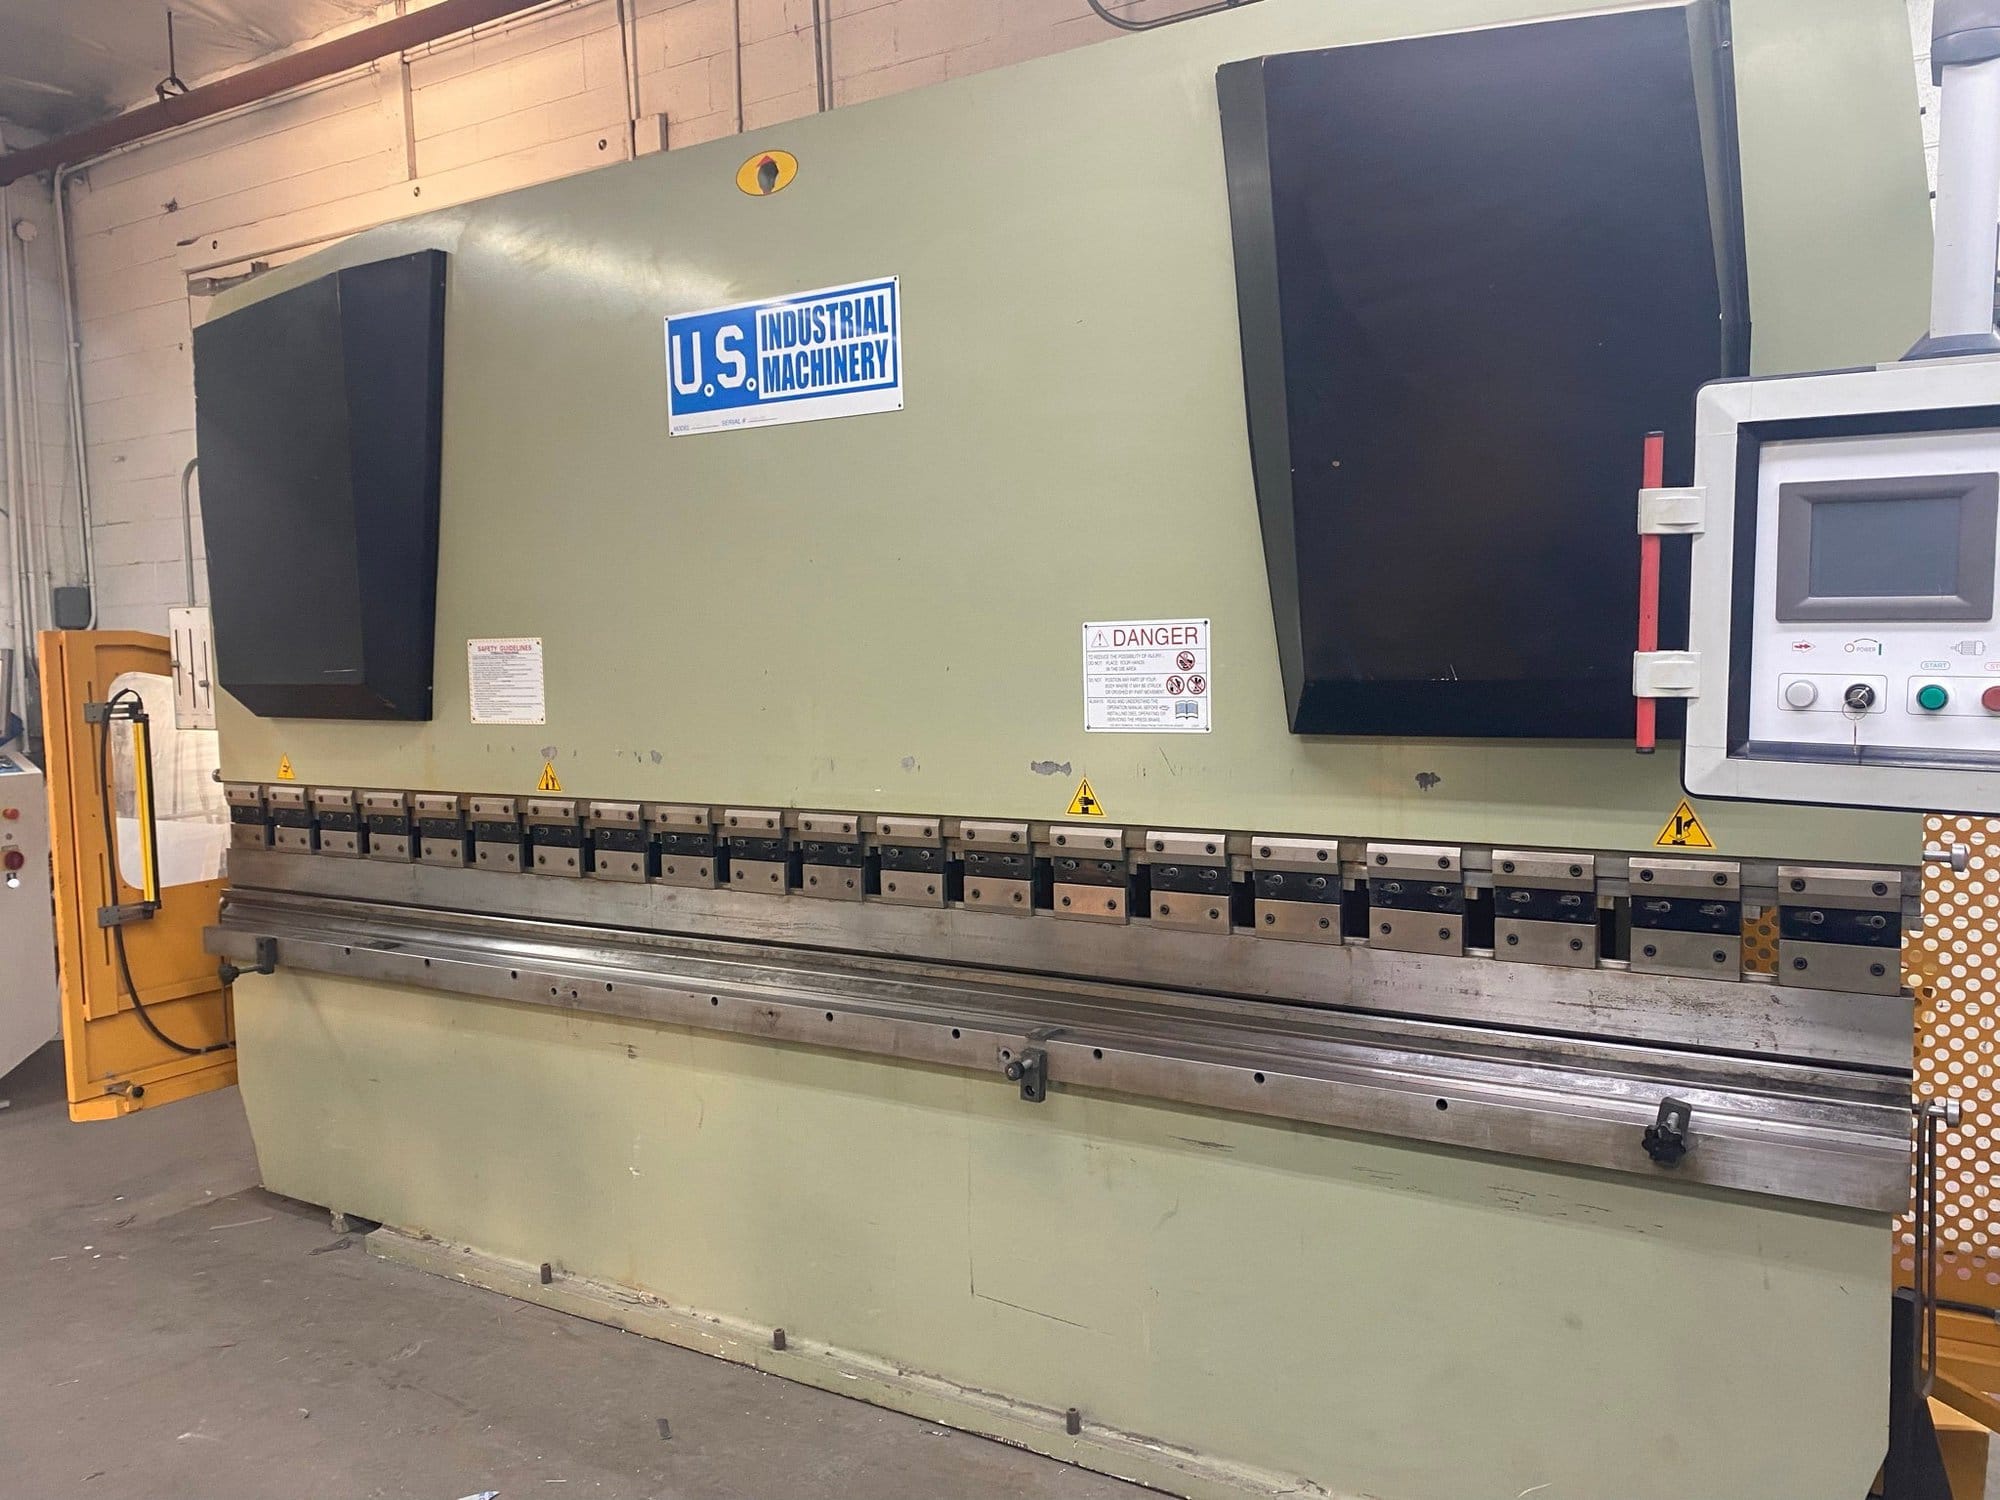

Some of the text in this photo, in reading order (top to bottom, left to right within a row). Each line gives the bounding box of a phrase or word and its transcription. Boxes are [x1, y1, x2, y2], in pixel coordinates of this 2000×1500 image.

[760, 294, 889, 352] INDUSTRIAL
[672, 324, 757, 397] U.S.
[762, 338, 889, 394] MACHINERY
[722, 418, 741, 427] SERIAL
[1113, 626, 1198, 647] DANGER
